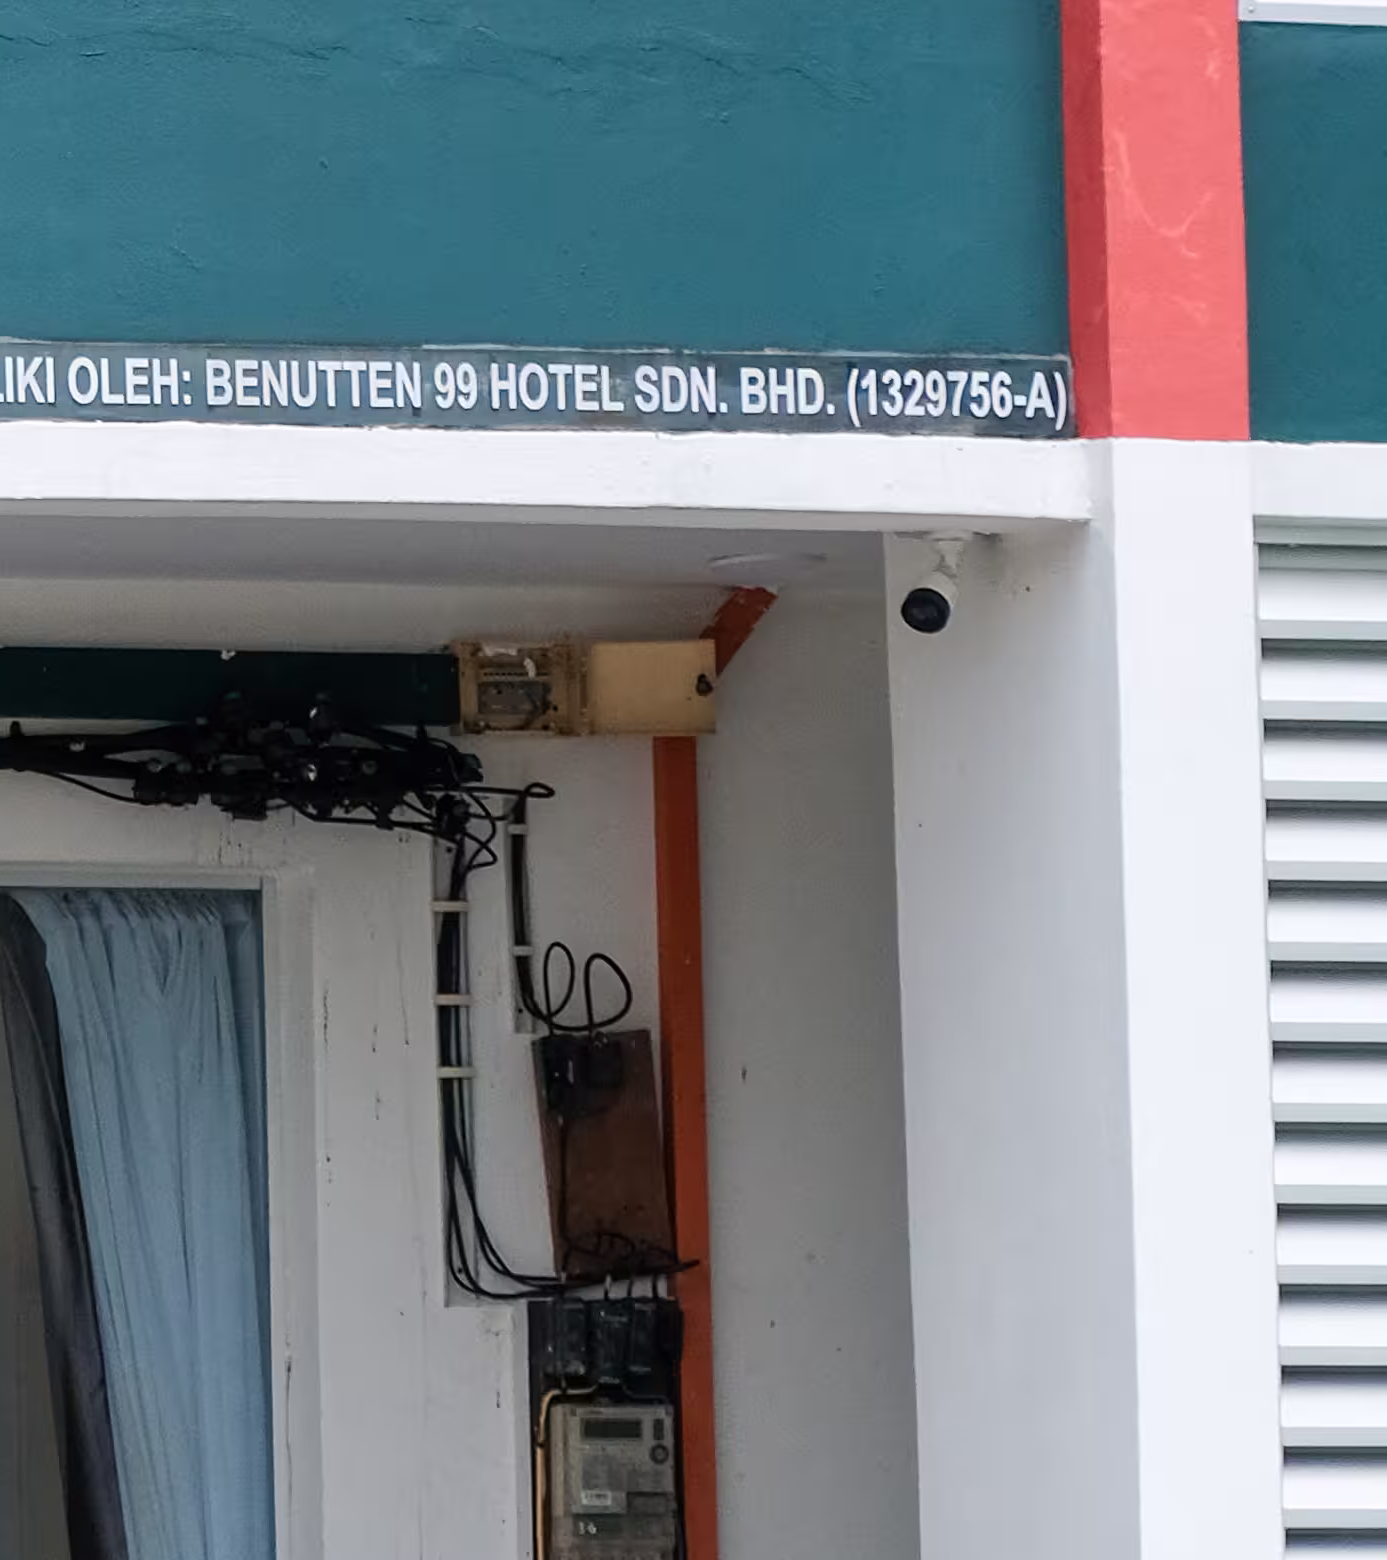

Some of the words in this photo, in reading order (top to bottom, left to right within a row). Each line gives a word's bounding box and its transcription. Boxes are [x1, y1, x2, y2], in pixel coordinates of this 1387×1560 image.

[67, 356, 193, 406] OLEH:
[205, 358, 422, 410] BENUTTEN
[433, 362, 479, 412] 99
[490, 363, 624, 412] HOTEL
[634, 365, 729, 414] SDN.
[740, 367, 835, 416] BHD.
[846, 368, 1068, 431] (1329756-A)
